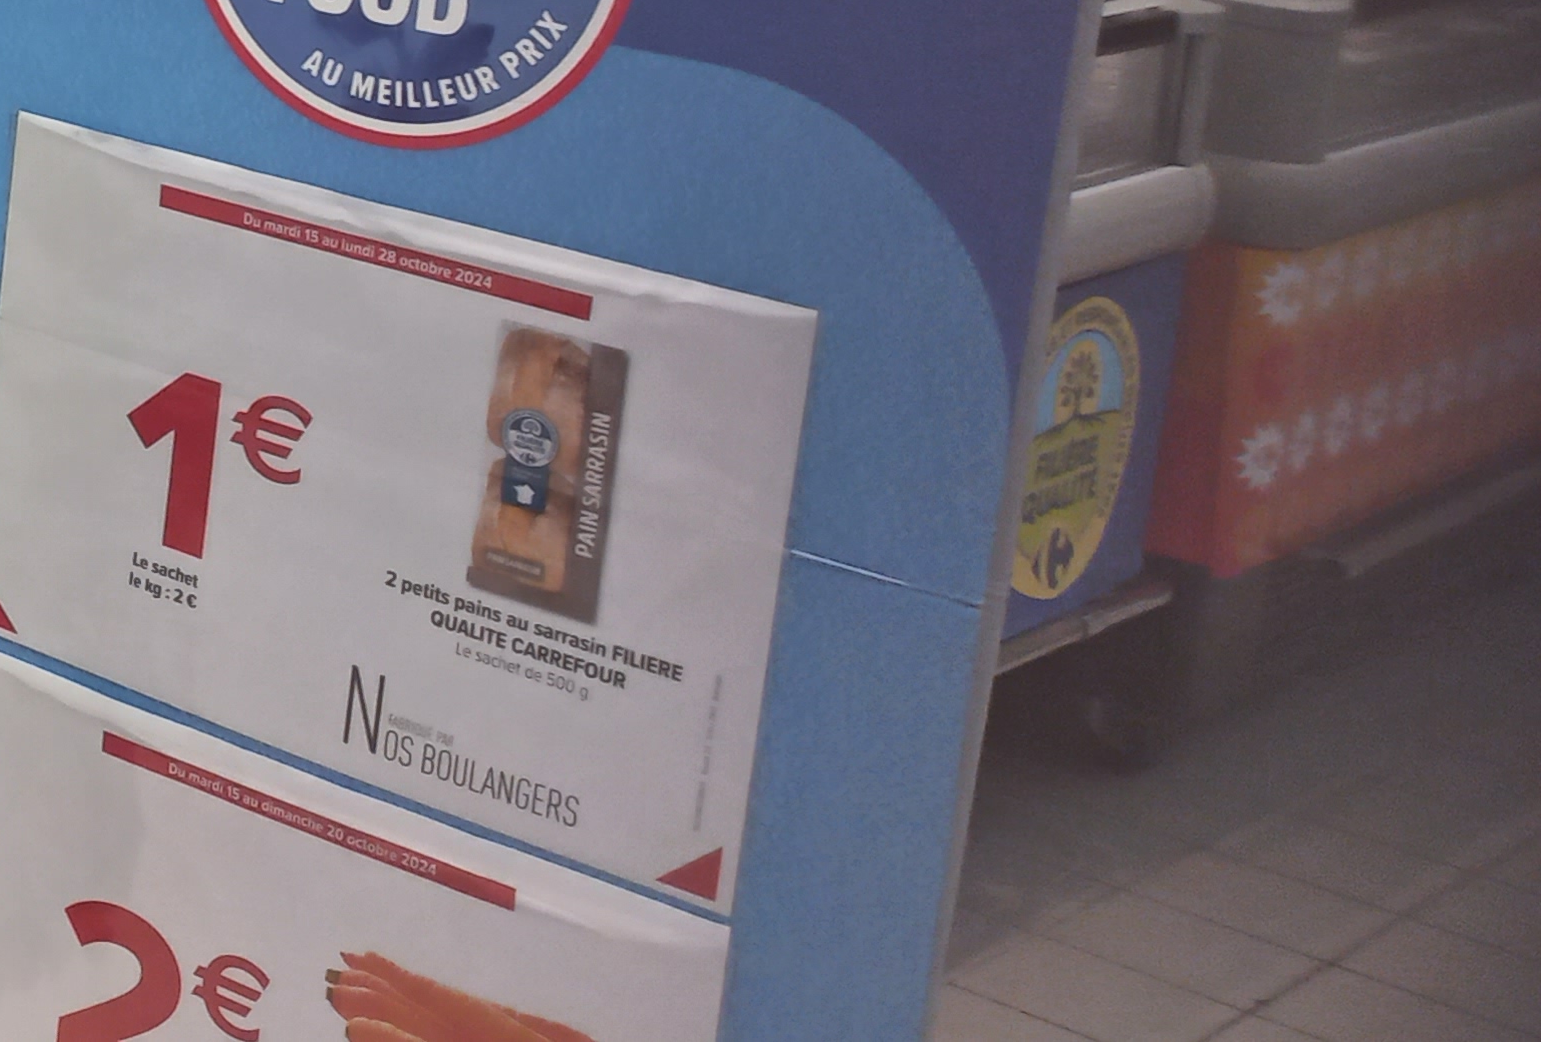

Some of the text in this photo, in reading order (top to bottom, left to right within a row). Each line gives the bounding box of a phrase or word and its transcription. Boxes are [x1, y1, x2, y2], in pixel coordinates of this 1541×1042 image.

[300, 9, 570, 110] AU MEILLEUR PRIX
[242, 210, 493, 291] Du mardi 15 au lundi 28 octobre 2024
[573, 410, 613, 560] PAIN SARRASIN
[128, 571, 143, 589] le
[144, 577, 162, 600] kg
[173, 588, 184, 606] 2
[132, 551, 200, 589] Le sachet
[384, 570, 685, 684] 2 petits pains au sarrasin FILIERE
[430, 610, 627, 690] QUALITE CARREFOUR
[454, 641, 590, 702] Le sachet de 500 g
[168, 761, 439, 877] Du mardi 15 au dimanche 20 octobre 2024
[420, 742, 581, 829] BOULANGERS
